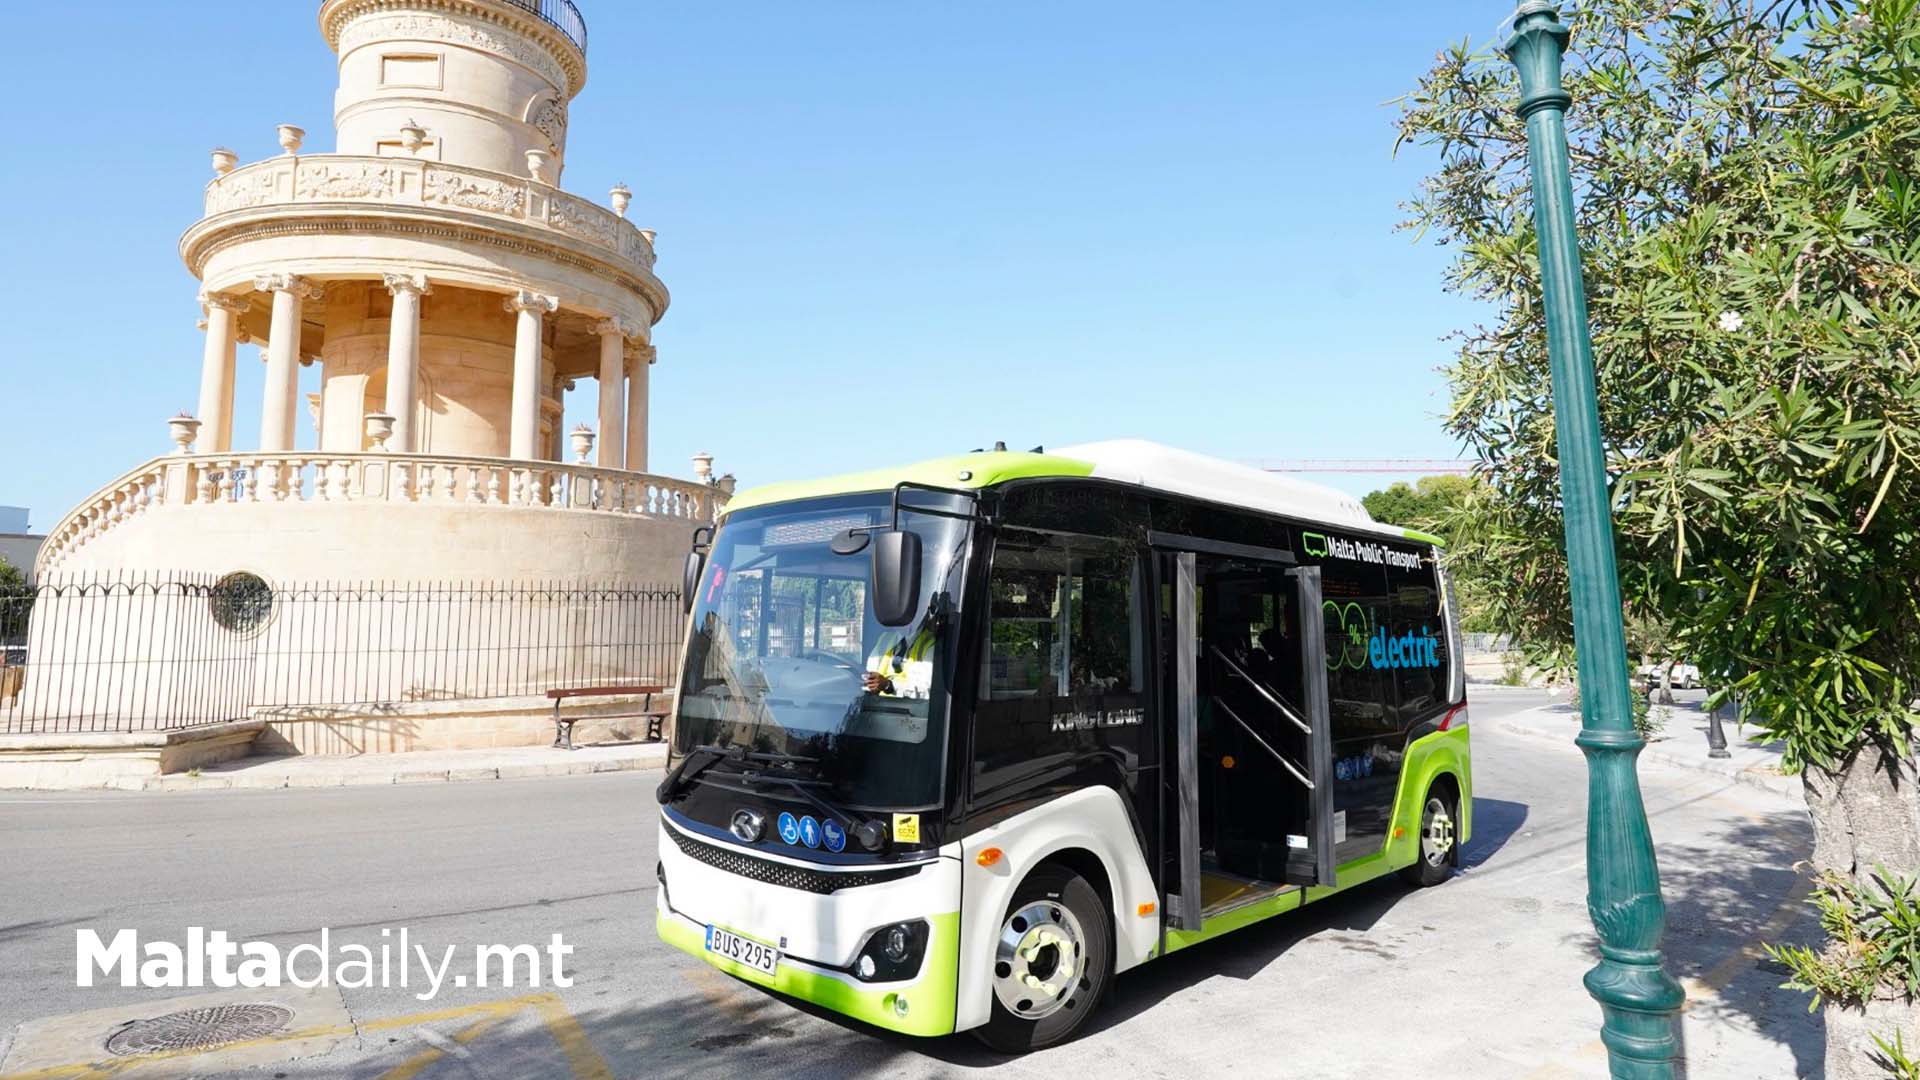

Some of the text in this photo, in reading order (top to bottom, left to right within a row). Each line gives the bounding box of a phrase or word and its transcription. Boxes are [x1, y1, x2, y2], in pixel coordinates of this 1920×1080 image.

[1327, 536, 1422, 573] Malta Public Transport
[1369, 624, 1440, 670] electric
[714, 930, 772, 969] BUS 295
